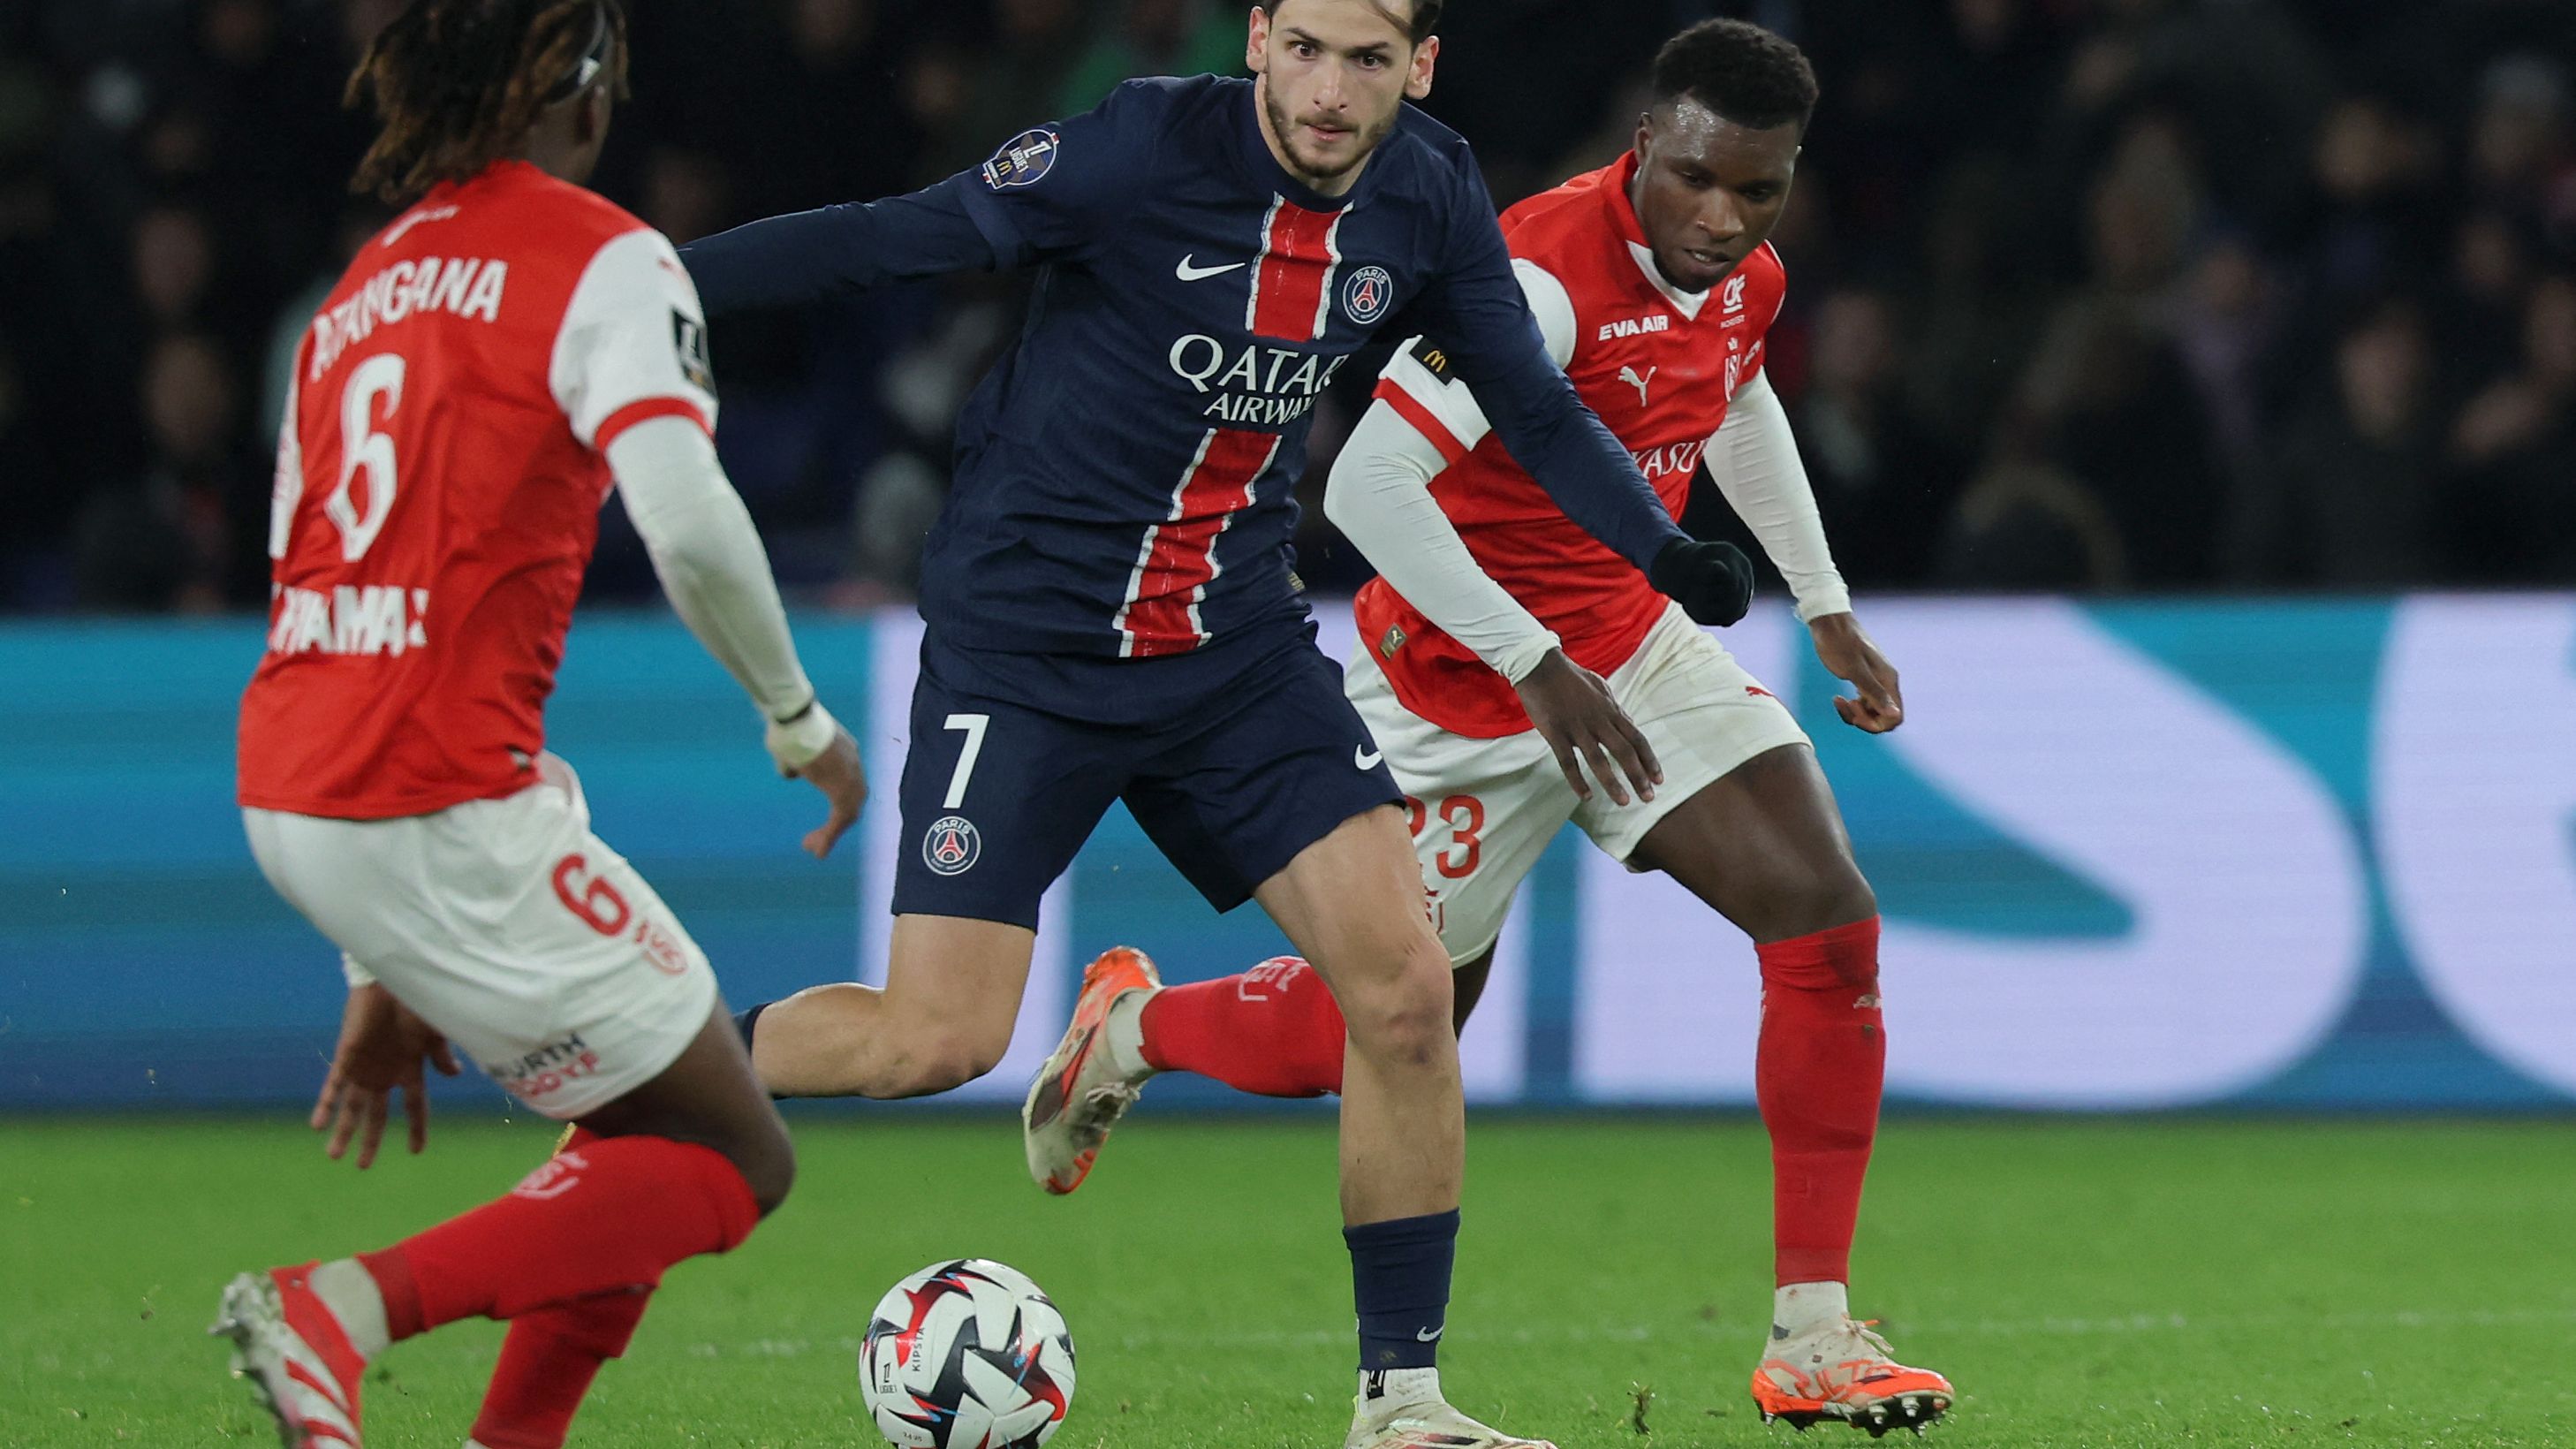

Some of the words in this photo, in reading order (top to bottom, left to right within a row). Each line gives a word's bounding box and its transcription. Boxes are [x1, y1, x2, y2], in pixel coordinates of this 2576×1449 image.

[1355, 269, 1387, 284] PARIS
[1598, 319, 1640, 341] EVA
[1641, 315, 1669, 333] AIR
[1169, 334, 1350, 393] QATAR
[323, 353, 405, 563] 6
[943, 714, 990, 808] 7
[935, 820, 971, 835] PARIS
[551, 853, 631, 937] 6
[912, 1327, 925, 1372] KIPSTA
